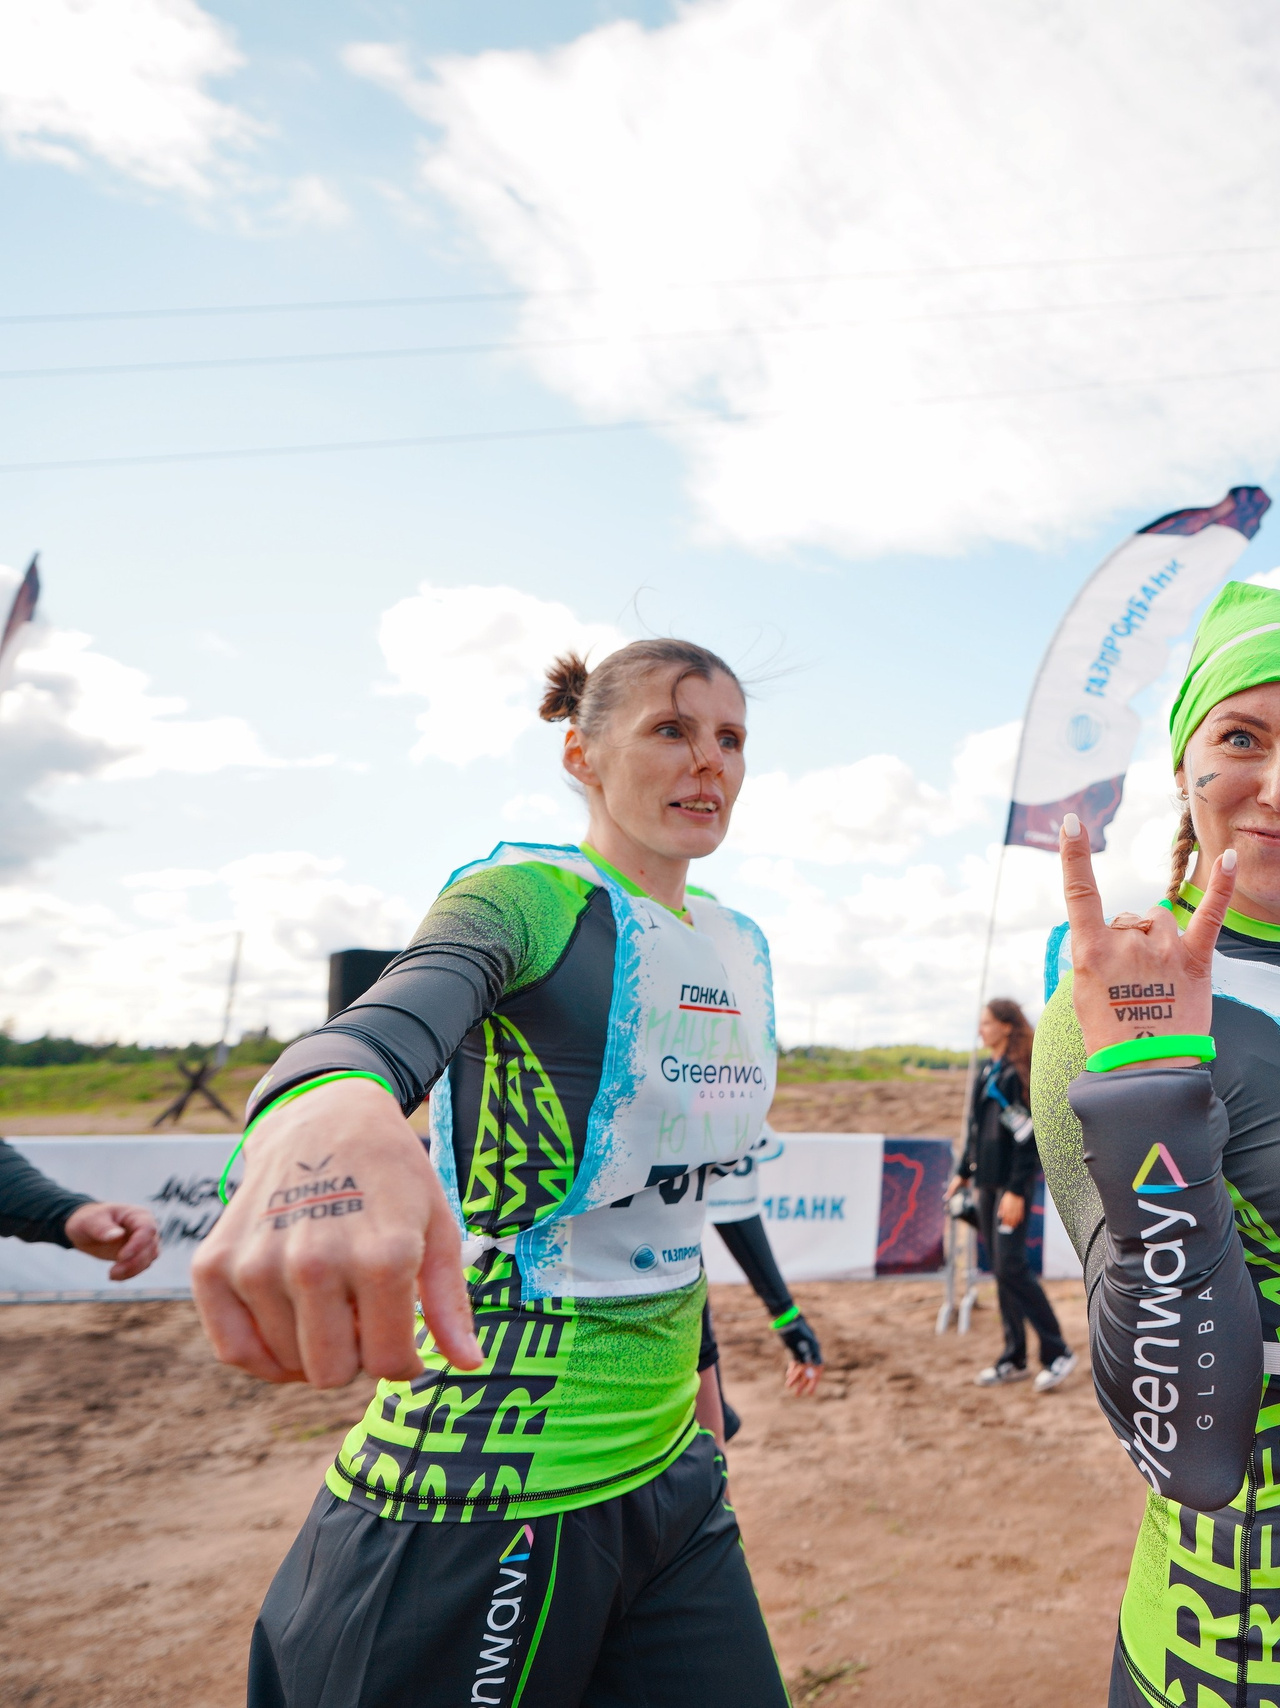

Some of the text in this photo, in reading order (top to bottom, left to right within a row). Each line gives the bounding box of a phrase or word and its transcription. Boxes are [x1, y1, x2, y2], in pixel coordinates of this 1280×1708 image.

[1084, 558, 1184, 698] ГАЗПРОМБАНК
[680, 983, 730, 1007] ГОНКА
[1108, 983, 1175, 1000] ГЕРОЕВ
[1114, 1004, 1173, 1023] ГОНКА
[699, 1090, 754, 1099] GLOBAL
[267, 1176, 358, 1208] ГОНКА
[1196, 1283, 1216, 1432] GLOBA
